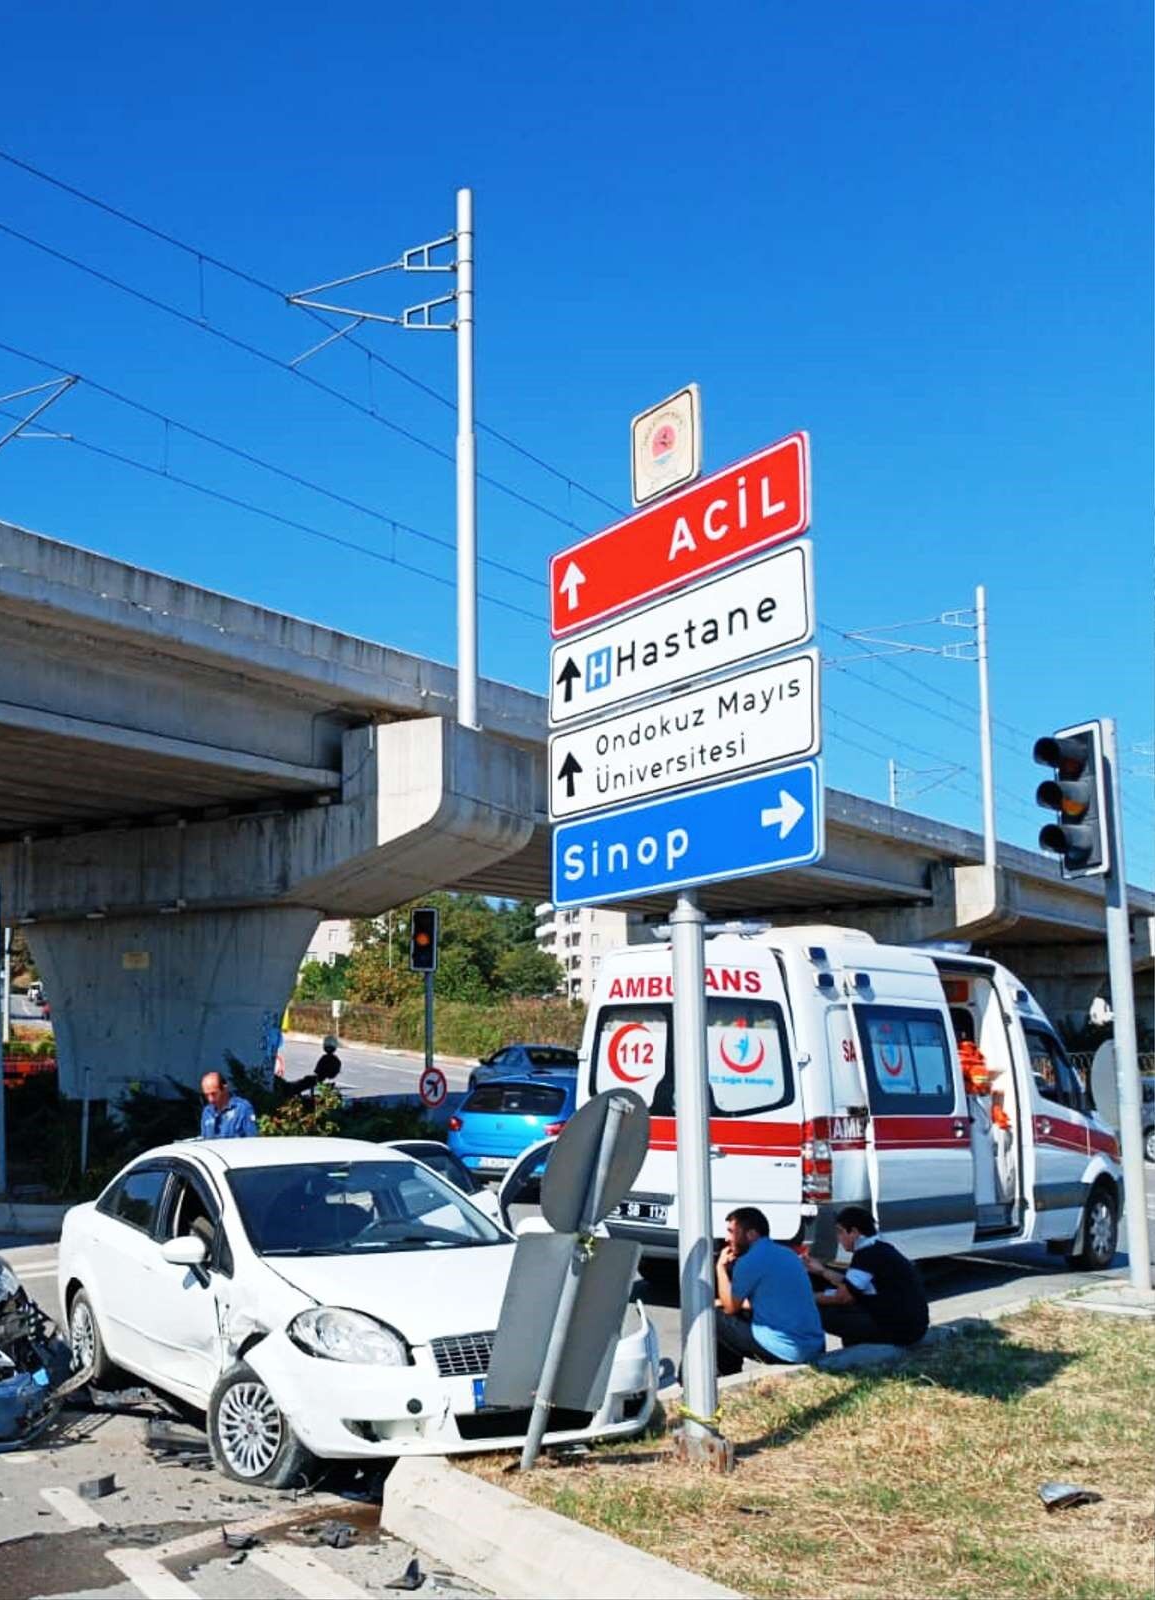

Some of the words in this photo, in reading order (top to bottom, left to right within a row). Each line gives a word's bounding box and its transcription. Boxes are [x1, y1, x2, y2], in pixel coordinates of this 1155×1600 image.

[667, 476, 786, 561] ACİL
[616, 596, 777, 677] Hastane
[596, 708, 705, 756] Ondokuz
[718, 678, 801, 719] Mayıs
[596, 732, 746, 794] Üniversitesi
[563, 828, 689, 882] Sinop
[608, 967, 762, 999] AMBUANS
[620, 1043, 654, 1065] 112
